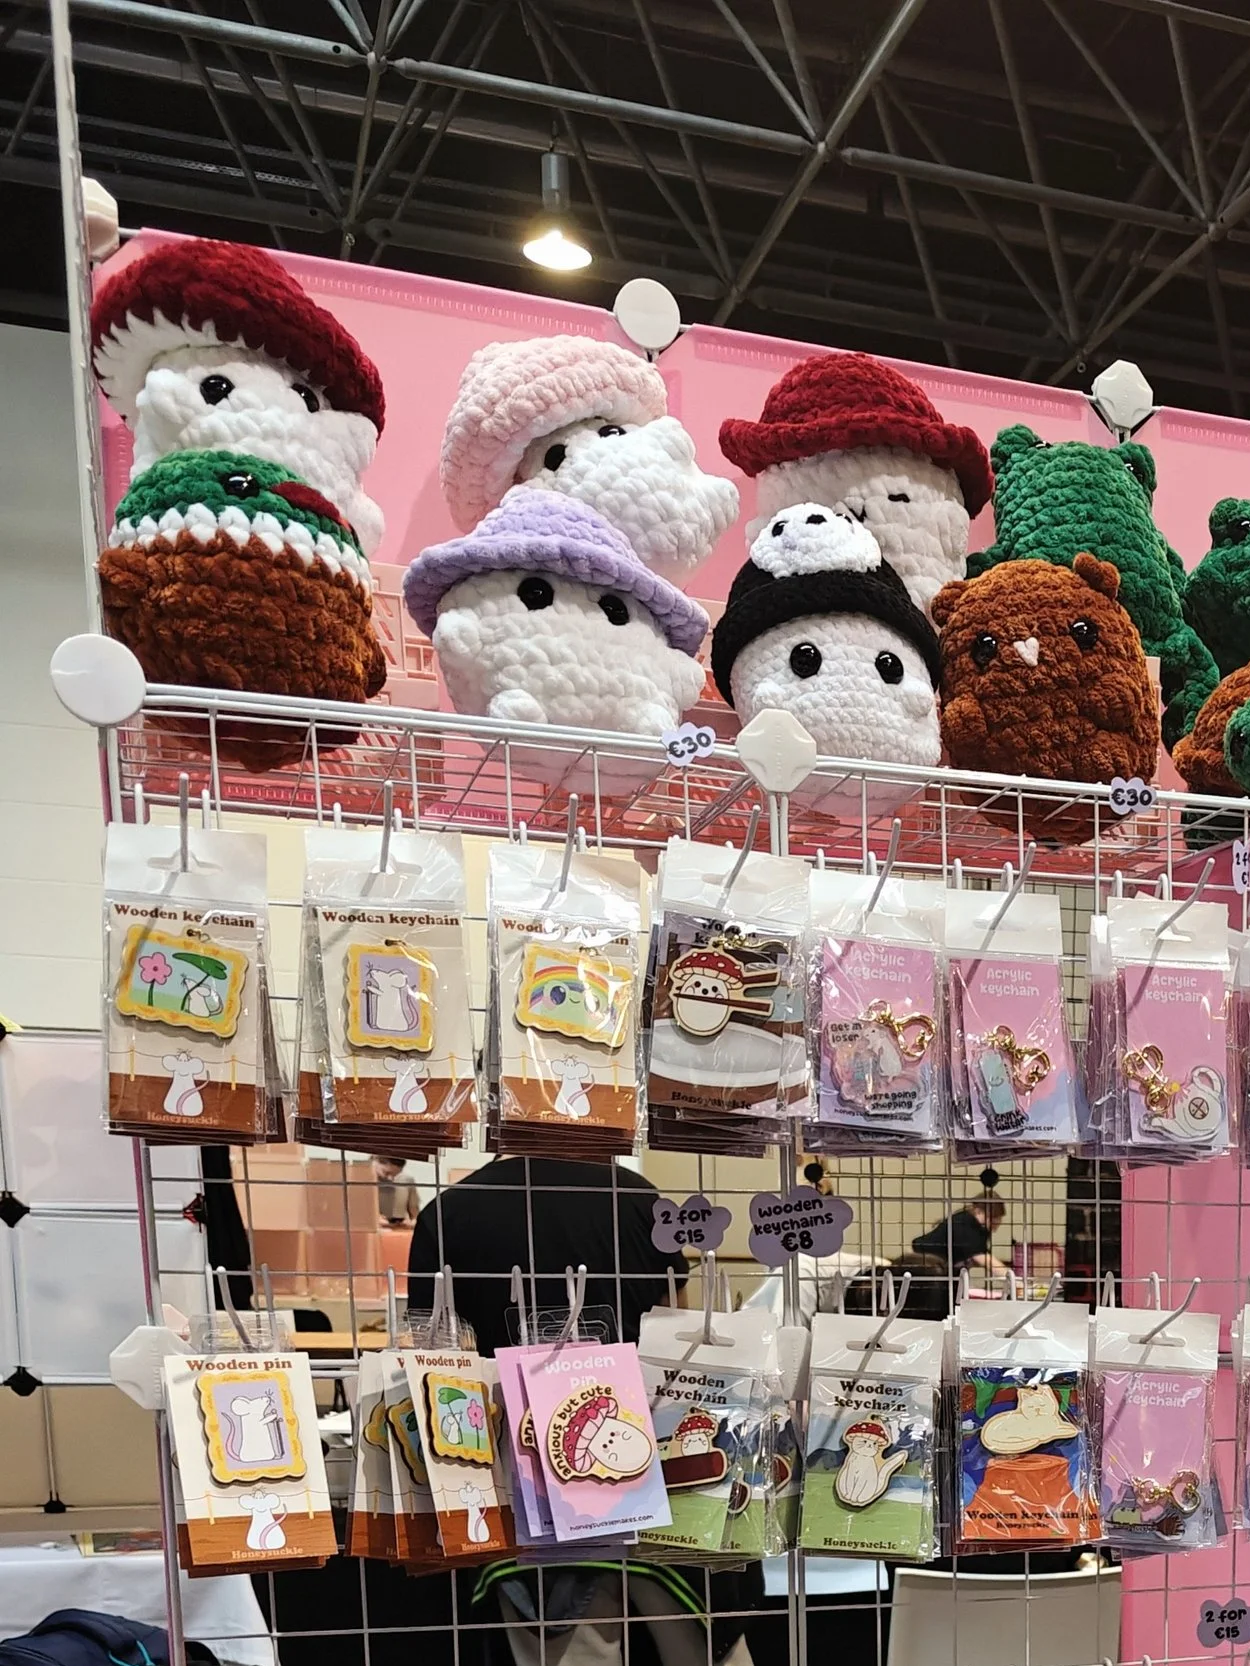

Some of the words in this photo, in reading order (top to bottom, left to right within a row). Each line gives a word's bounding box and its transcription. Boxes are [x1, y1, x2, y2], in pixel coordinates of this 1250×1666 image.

[668, 732, 711, 758] €30
[1111, 788, 1152, 806] €30
[114, 904, 178, 921] Wooden
[323, 912, 384, 925] Wooden
[389, 913, 459, 927] keychain
[987, 968, 1032, 981] Acrylic
[1152, 974, 1197, 987] Acrylic
[832, 1032, 859, 1043] loser
[661, 1211, 672, 1224] 2
[677, 1208, 712, 1223] for
[758, 1199, 823, 1218] wooden
[753, 1213, 834, 1236] keychains
[674, 1229, 705, 1244] €15
[781, 1230, 813, 1251] €8
[186, 1360, 261, 1372] Wooden
[264, 1357, 292, 1372] pin
[414, 1355, 455, 1367] Wooden
[457, 1355, 472, 1369] pin
[580, 1385, 612, 1402] cute
[556, 1399, 580, 1419] but
[551, 1430, 572, 1477] anxious
[570, 1513, 654, 1532] honeysucklemakes.com
[1205, 1610, 1215, 1623] 2
[1218, 1606, 1247, 1622] for
[1214, 1626, 1240, 1639] €15
